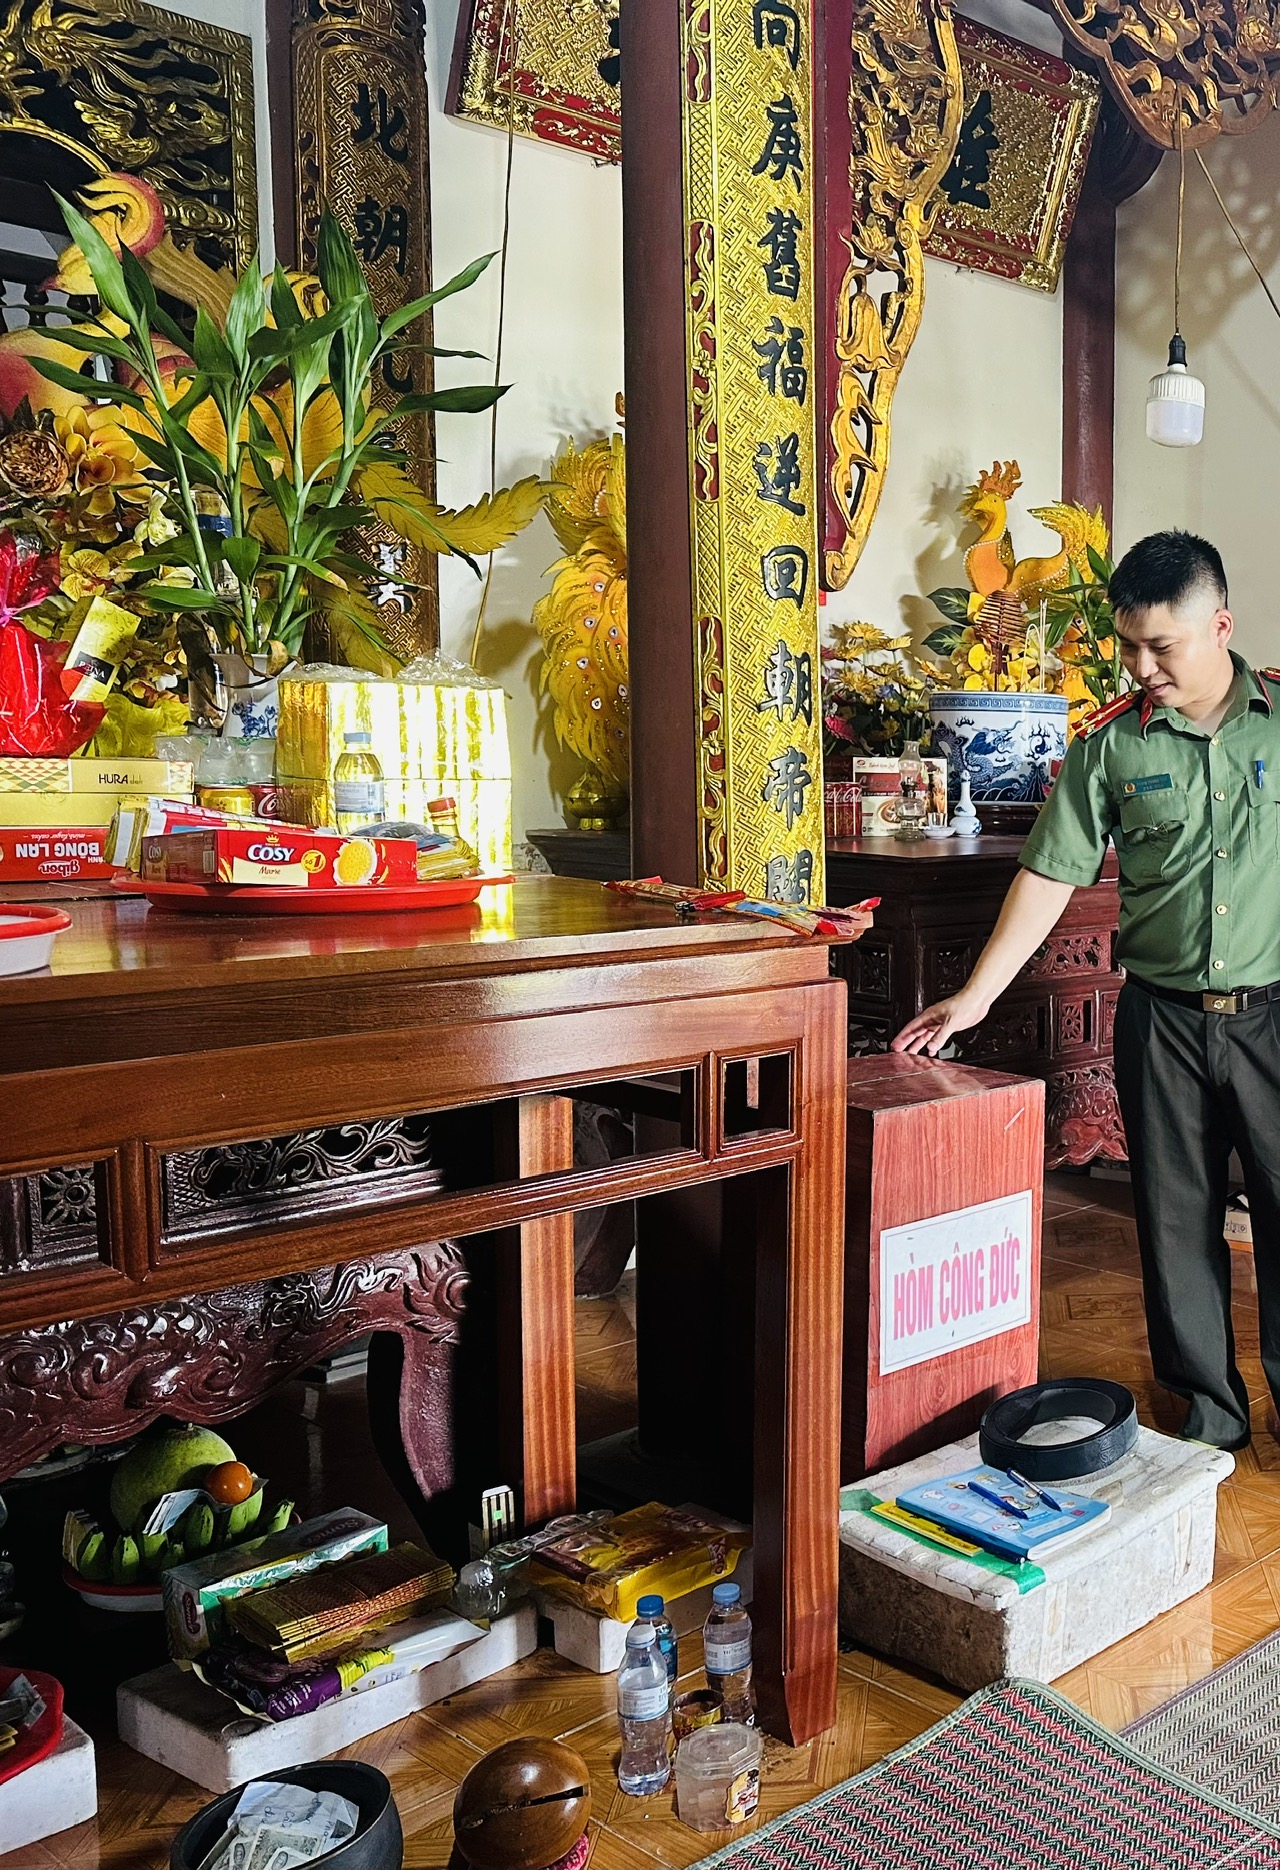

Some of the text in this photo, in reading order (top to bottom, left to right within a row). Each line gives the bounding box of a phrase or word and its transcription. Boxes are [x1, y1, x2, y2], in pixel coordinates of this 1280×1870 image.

[98, 773, 129, 785] HURA
[15, 843, 50, 858] LAN
[247, 843, 295, 862] COSY
[38, 859, 81, 877] gibon
[893, 1227, 1021, 1341] HÒM CÔNG ĐỨC
